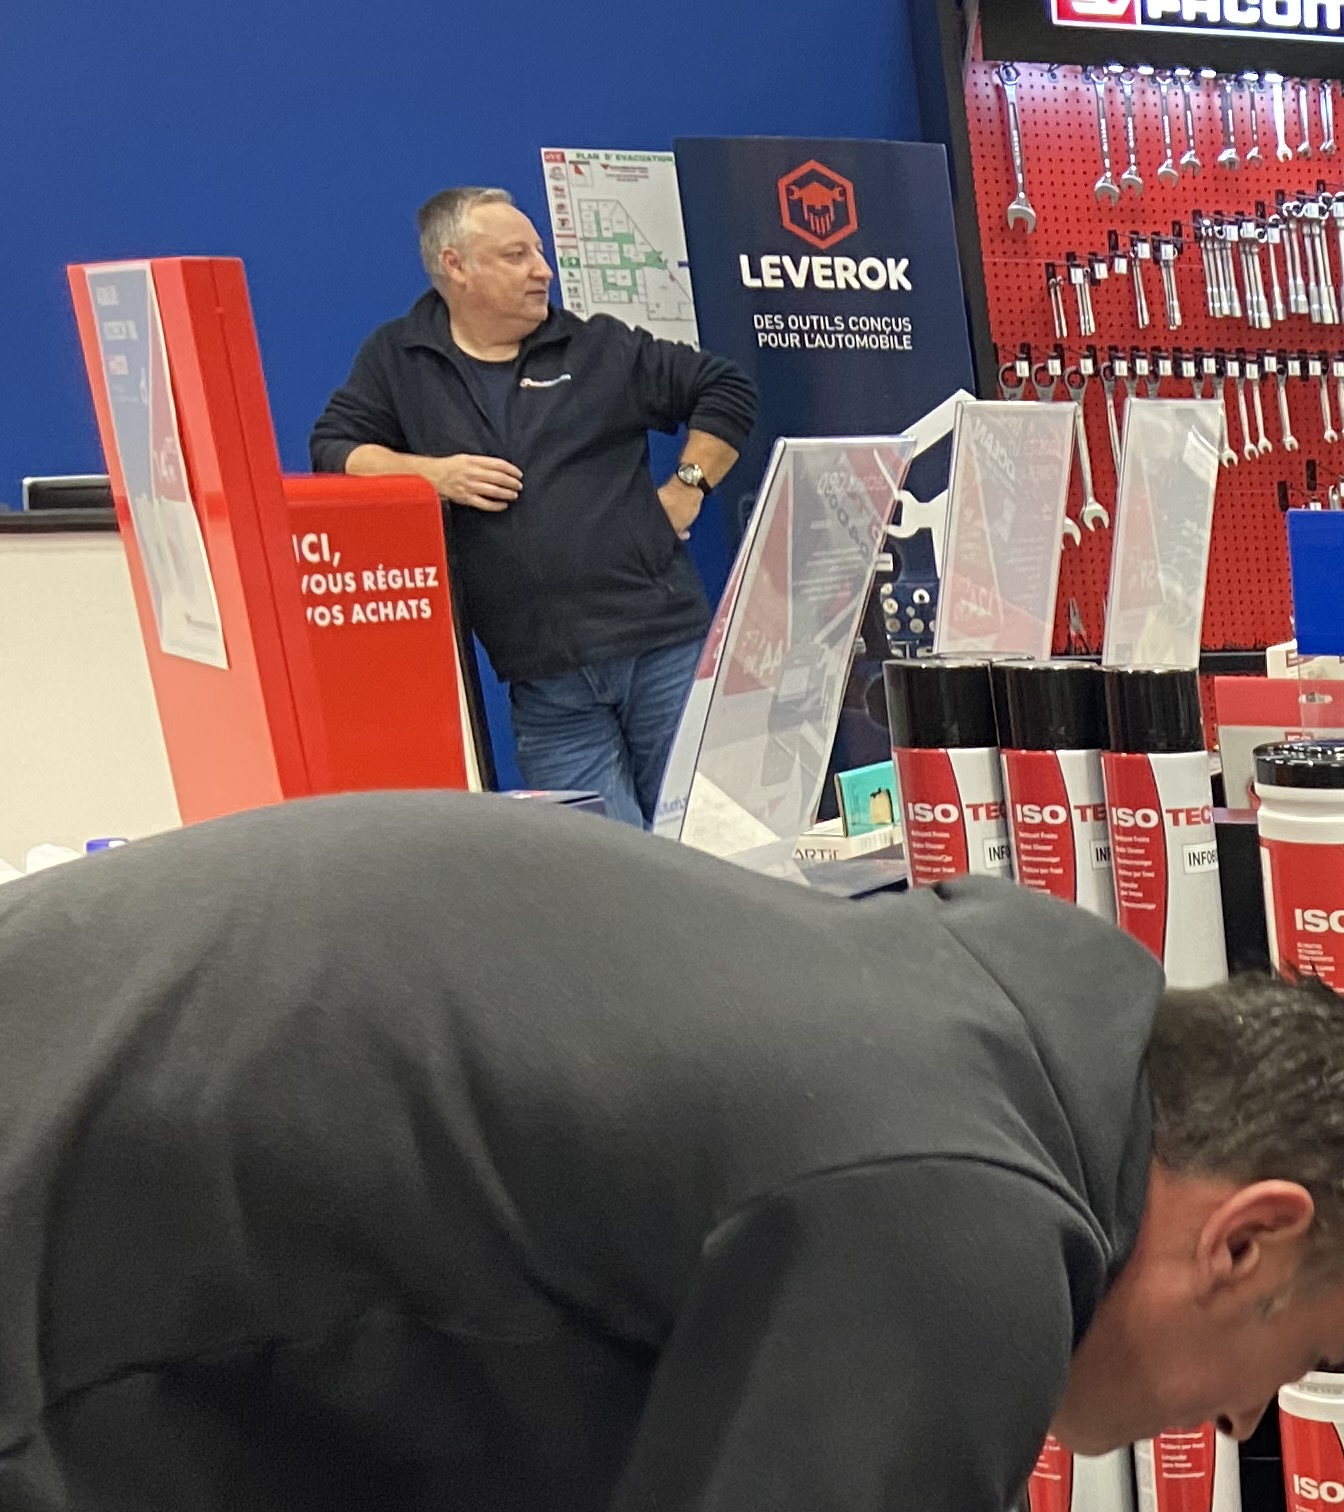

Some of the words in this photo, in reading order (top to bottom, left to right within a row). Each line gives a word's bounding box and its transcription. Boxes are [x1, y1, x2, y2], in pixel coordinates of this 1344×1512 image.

[739, 254, 913, 291] LEVEROK
[753, 313, 784, 330] DES
[787, 314, 845, 331] OUTILS
[848, 316, 912, 335] CONÇUS
[757, 332, 801, 349] POUR
[804, 333, 913, 350] L'AUTOMOBILE
[362, 563, 439, 591] RÉGLEZ
[351, 597, 432, 624] ACHATS
[907, 802, 959, 824] ISO
[1015, 803, 1067, 825] ISO
[1074, 802, 1106, 823] TE
[1112, 806, 1159, 829] ISO
[1165, 805, 1213, 827] TEC
